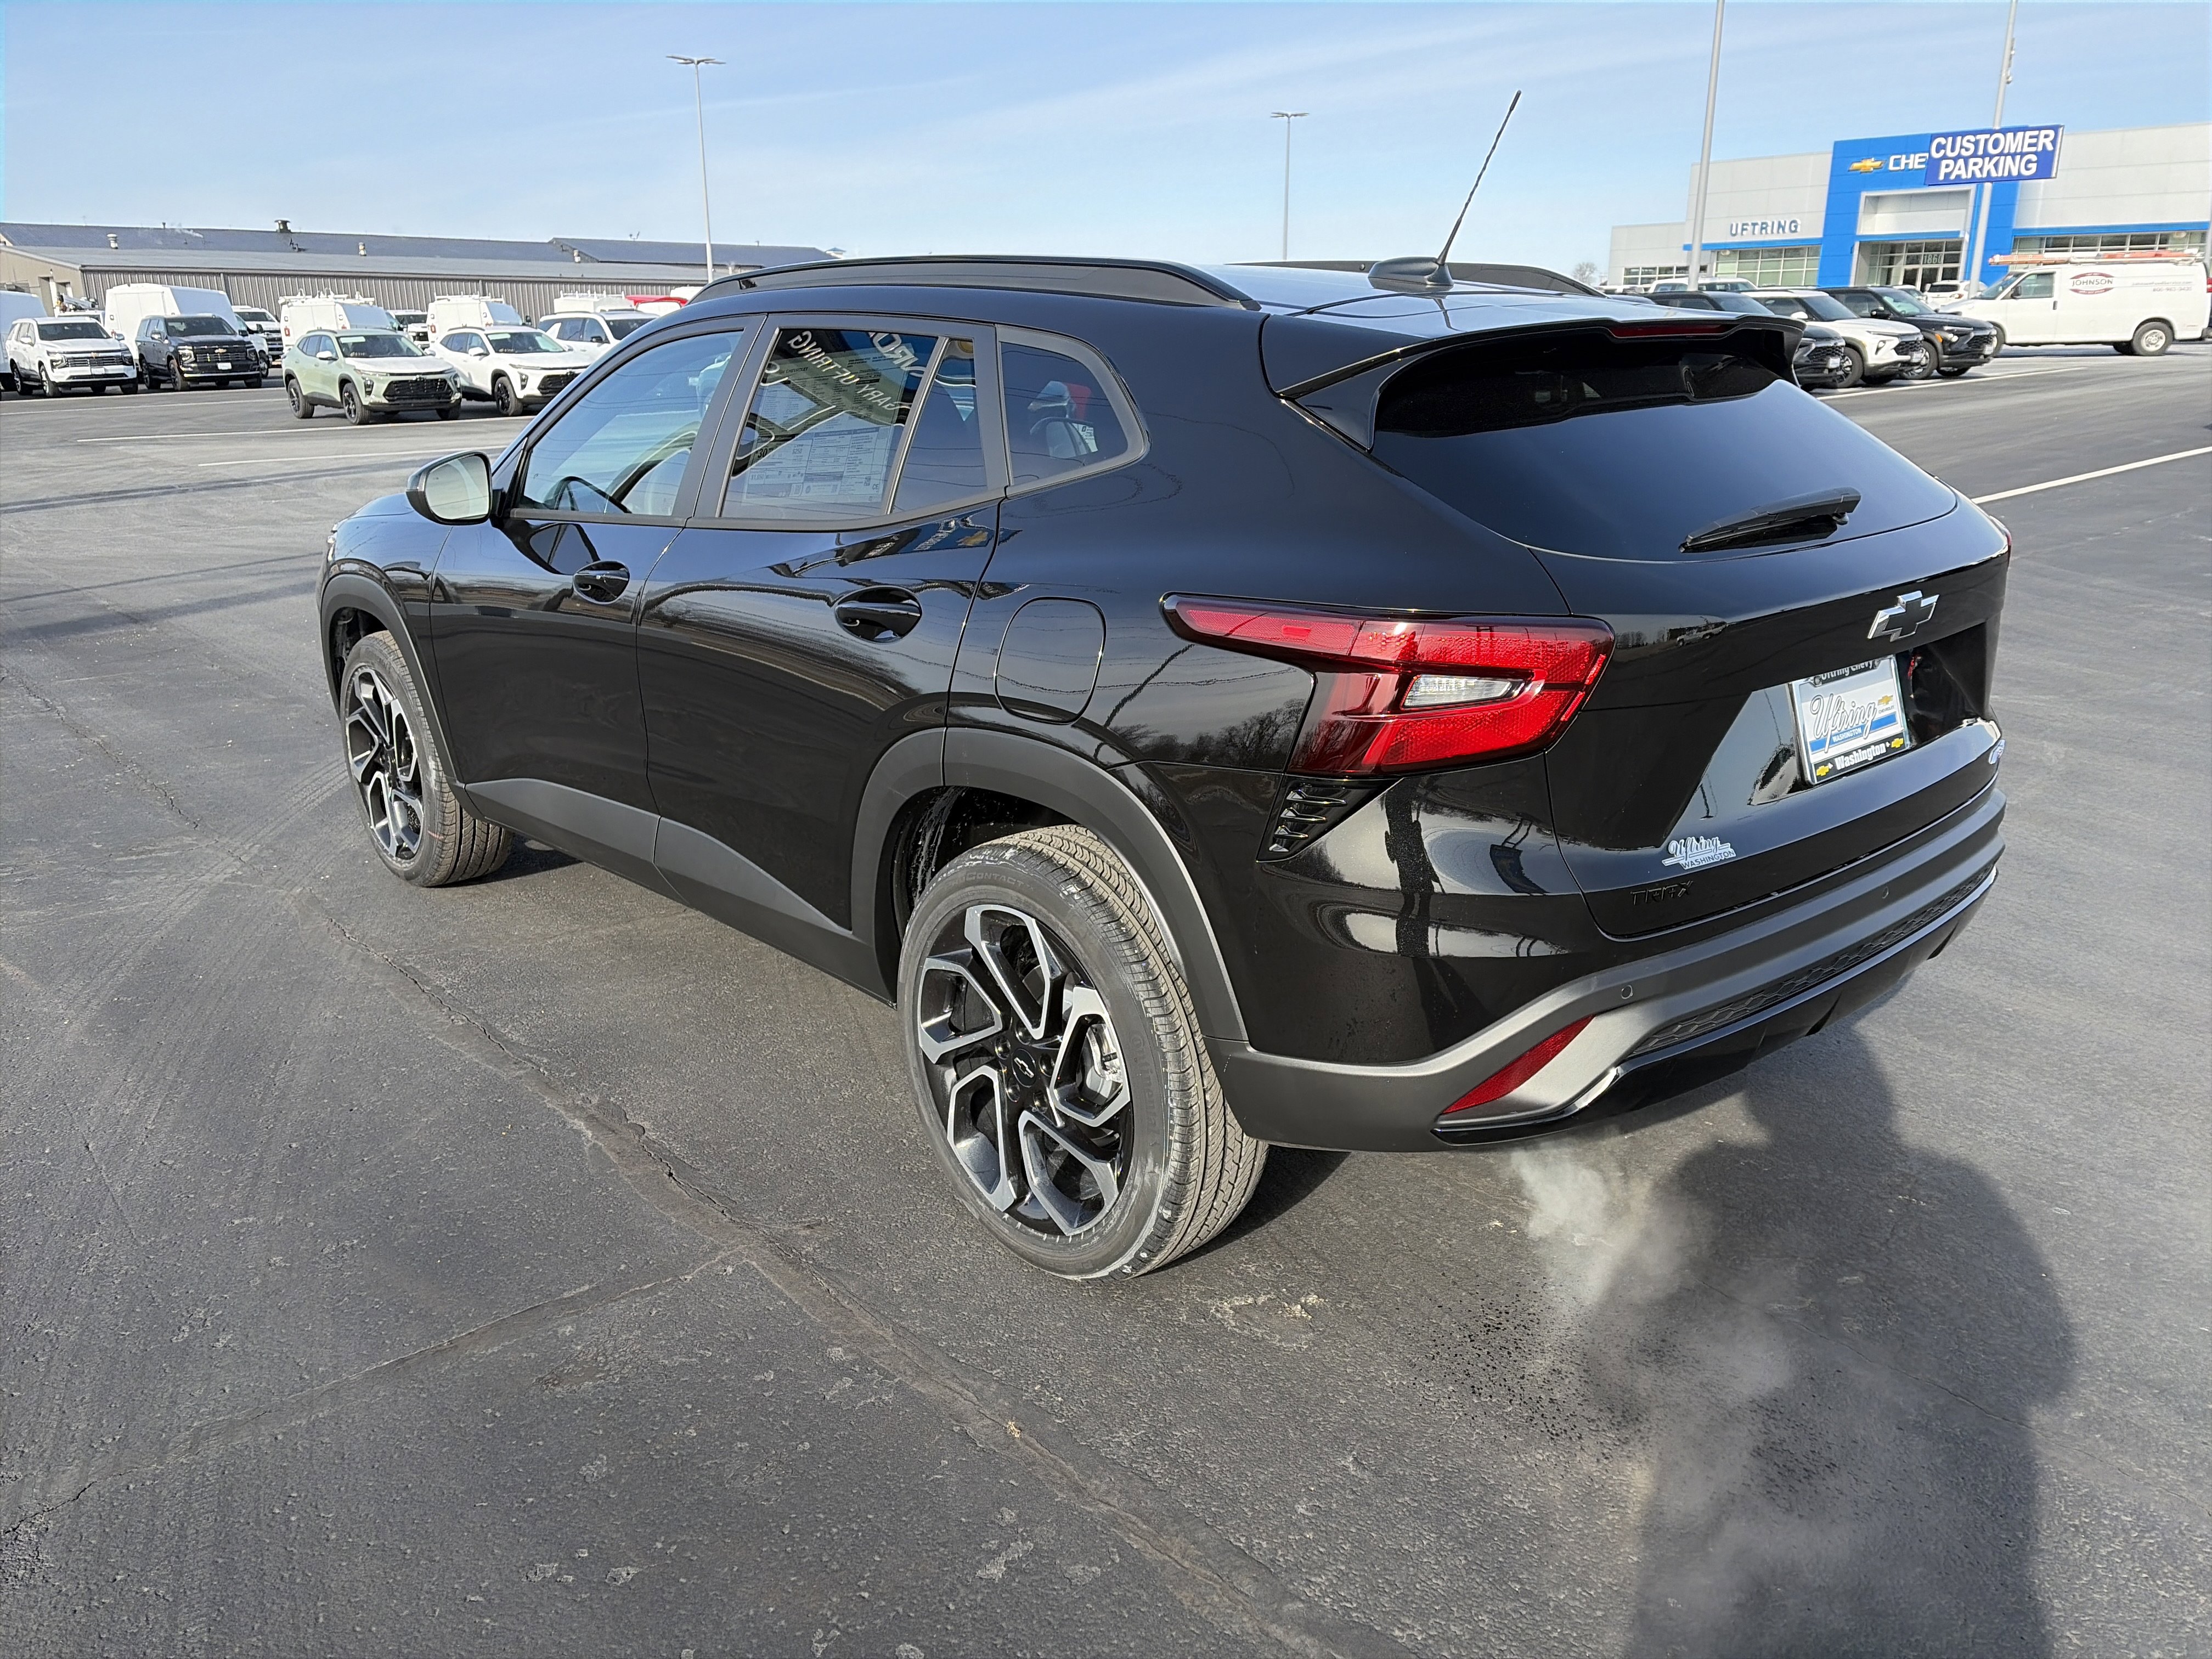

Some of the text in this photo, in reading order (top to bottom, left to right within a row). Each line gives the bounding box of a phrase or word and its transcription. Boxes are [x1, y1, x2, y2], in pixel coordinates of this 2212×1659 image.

[1930, 128, 2054, 159] CUSTOMER
[1888, 153, 1929, 172] CHE
[1938, 154, 2038, 180] PARKING
[1730, 219, 1800, 236] UFTRING
[1923, 253, 1943, 264] 1860
[2072, 279, 2113, 287] JOHNSON
[1810, 693, 1877, 753] Uftring
[1832, 727, 1863, 743] WASHINGTON
[1835, 743, 1887, 770] Washington
[1668, 836, 1721, 861] Uftring
[1681, 850, 1735, 869] WASHINGTON
[1629, 880, 1694, 906] TRAX
